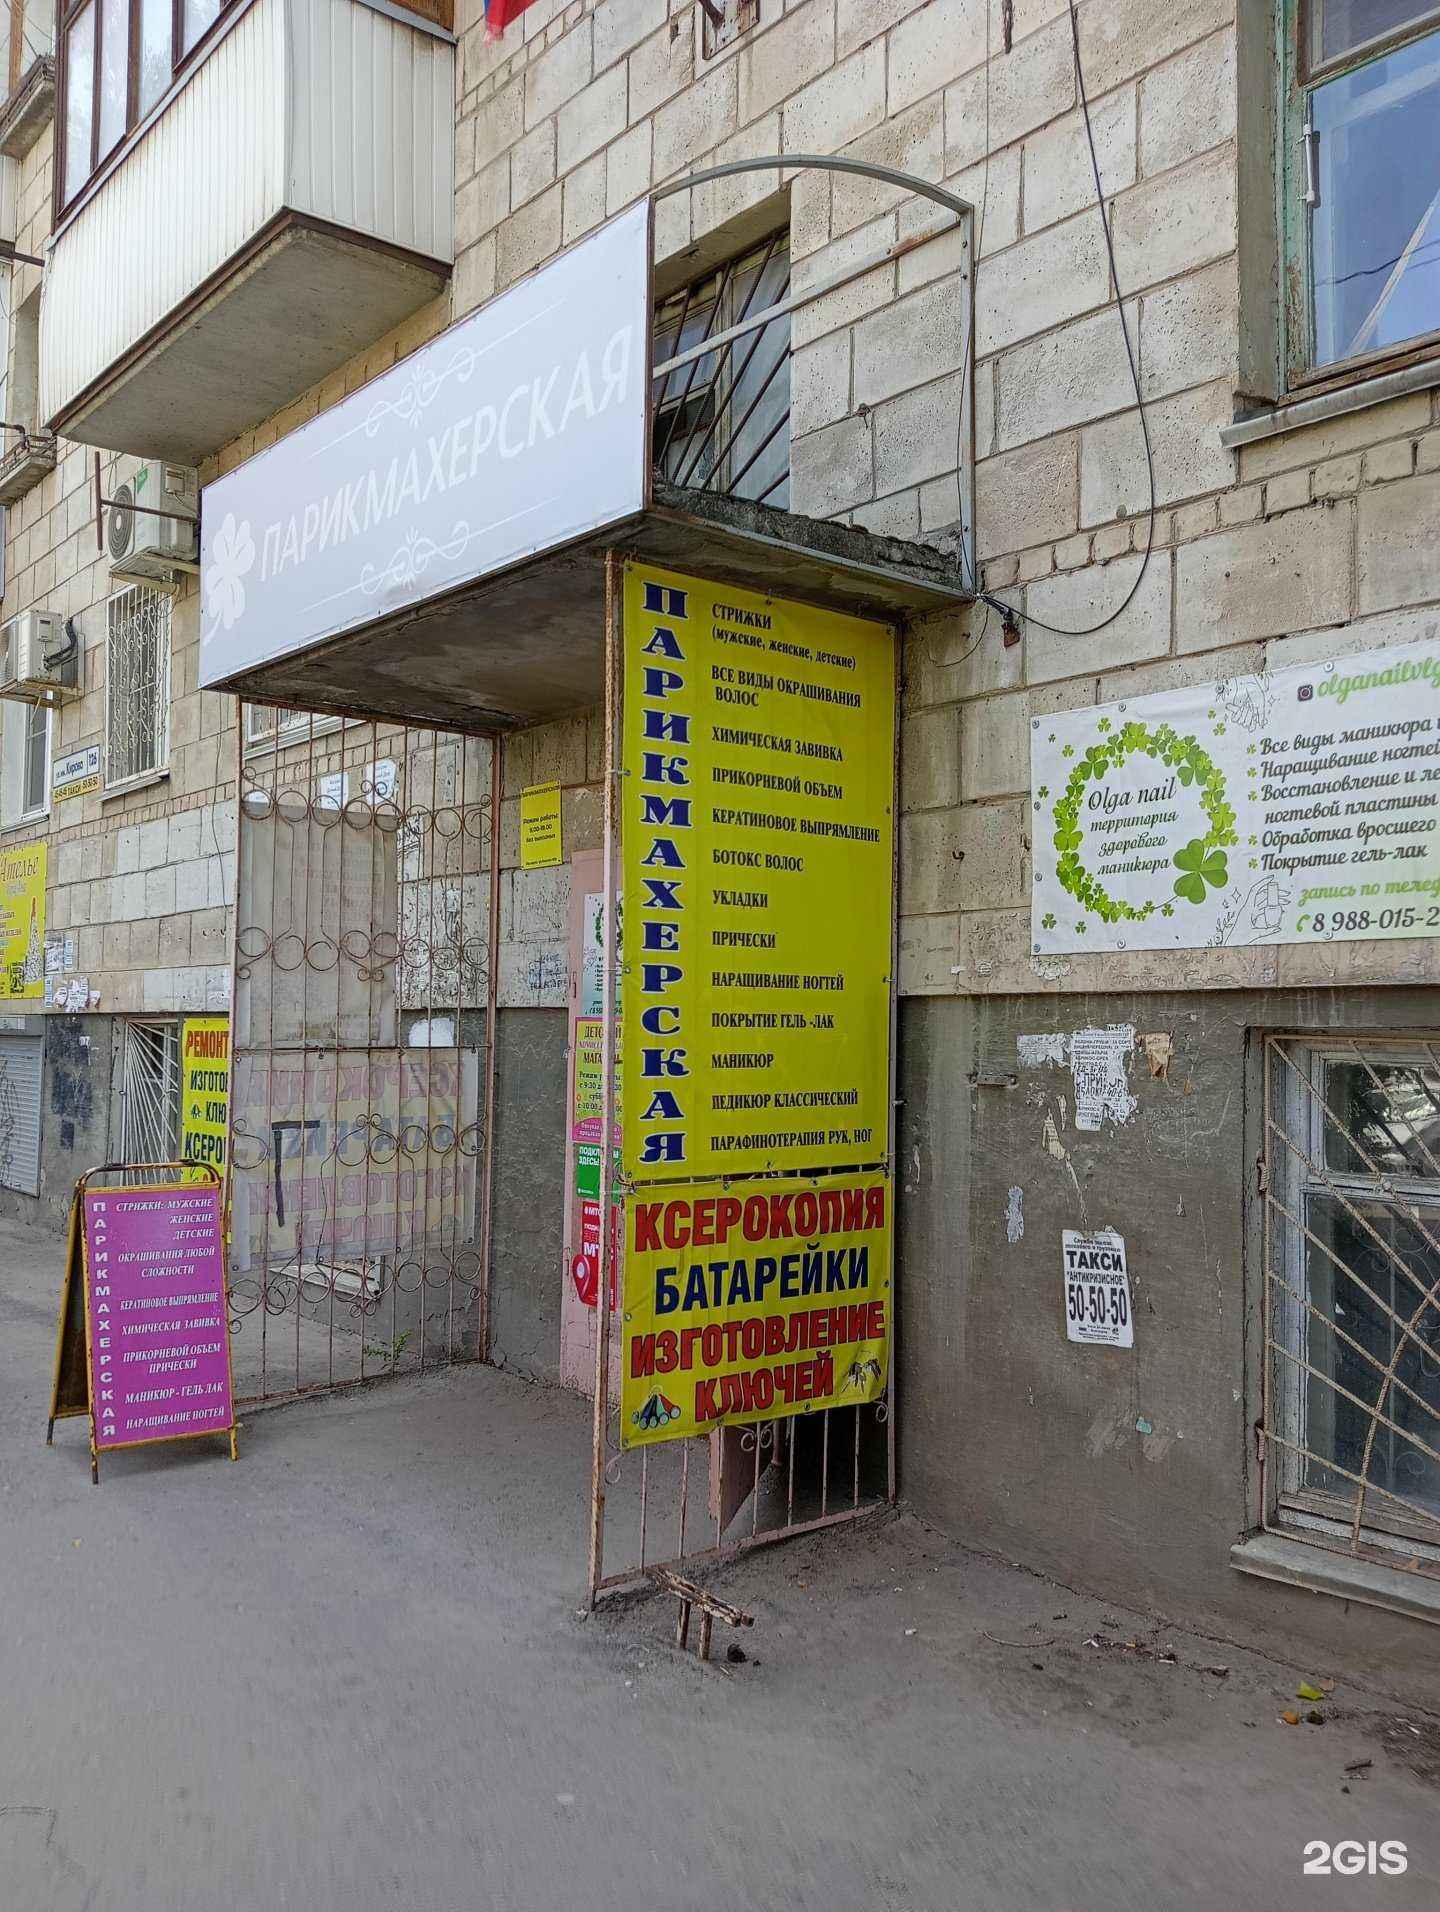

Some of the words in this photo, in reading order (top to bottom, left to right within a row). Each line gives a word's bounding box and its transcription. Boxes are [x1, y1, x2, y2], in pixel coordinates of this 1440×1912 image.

[261, 325, 633, 582] ПАРИКМАХЕРСКАЯ
[712, 603, 772, 630] СТРИЖКИ
[769, 639, 813, 661] женские,
[815, 653, 857, 672] детские)
[712, 665, 735, 683] ВСЕ
[738, 670, 774, 691] ВИДЫ
[777, 677, 861, 708] ОКРАШИВАНИЯ
[715, 686, 759, 707] ВОЛОС
[712, 726, 791, 753] ХИМИЧЕСКАЯ
[795, 740, 843, 762] ЗАВИВКА
[1260, 737, 1290, 755] Все
[1293, 734, 1335, 755] виды
[1339, 719, 1432, 744] маникюра
[1261, 751, 1380, 783] Наращивание
[712, 767, 801, 794] ПРИКОРНЕВОЙ
[804, 781, 843, 800] ОБЪЕМ
[1088, 787, 1133, 814] Olga
[1137, 776, 1176, 804] nail
[1261, 771, 1400, 801] Восстановление
[1404, 770, 1417, 783] и
[1265, 800, 1342, 824] ногтевой
[1345, 793, 1438, 815] пластины
[712, 808, 797, 832] КЕРАТИНОВОЕ
[800, 819, 880, 843] ВЫПРЯМЛЕНИЕ
[1090, 811, 1179, 833] территория
[1098, 832, 1168, 857] здорового
[1262, 828, 1353, 854] Обработка
[1357, 819, 1437, 845] вросшего
[713, 849, 762, 867] БОТОКС
[765, 854, 804, 872] ВОЛОС
[1097, 856, 1171, 875] маникюра
[1261, 851, 1349, 876] Покрытие
[1351, 845, 1428, 863] гель-лак
[640, 582, 692, 1163] ПАРИКМАХЕРСКАЯ
[713, 889, 768, 909] УКЛАДКИ
[1298, 884, 1357, 907] запись
[1360, 882, 1381, 897] по
[1312, 912, 1325, 932] 8
[1332, 906, 1440, 931] 988-015-2
[712, 930, 776, 948] ПРИЧЕСКИ
[712, 971, 800, 990] НАРАЩИВАНИЕ
[803, 973, 844, 991] НОГТЕЙ
[712, 1013, 777, 1028] ПОКРЫТИЕ
[781, 1014, 807, 1029] ГЕЛЬ
[712, 1053, 774, 1069] МАНИКЮР
[191, 1069, 228, 1091] ИЗГОТО
[712, 1094, 771, 1111] ПЕДИКЮР
[774, 1088, 858, 1108] КЛАССИЧЕСКИЙ
[711, 1130, 825, 1151] ПАРАФИНОТЕРАПИЯ
[828, 1130, 852, 1146] РУК,
[854, 1129, 872, 1143] НОГ
[116, 1201, 164, 1213] СТРИЖКИ:
[166, 1198, 213, 1210] МУЖСКИЕ
[168, 1213, 214, 1225] ЖЕНСКИЕ
[635, 1187, 884, 1252] КСЕРОКОПИЯ
[172, 1228, 215, 1240] ДЕТСКИЕ
[184, 1245, 215, 1259] ЛЮБОЙ
[1066, 1250, 1123, 1272] ТАКСИ
[141, 1265, 195, 1278] СЛОЖНОСТИ
[655, 1242, 869, 1315] БАТАРЕЙКИ
[120, 1297, 167, 1311] КЕРАТИНОВОЕ
[92, 1202, 116, 1436] ПАРИКМАХЕРСКАЯ
[121, 1321, 180, 1336] ХИМИЧЕСКАЯ
[184, 1317, 220, 1330] ЗАВИВКА
[631, 1301, 885, 1378] ИЗГОТОВЛЕНИЕ
[123, 1344, 189, 1363] ПРИКОРНЕВОЙ
[190, 1342, 221, 1355] ОБЪЕМ
[149, 1359, 197, 1374] ПРИЧЕСКИ
[125, 1390, 175, 1405] МАНИКЮР
[695, 1350, 834, 1423] КЛЮЧЕЙ
[126, 1412, 191, 1430] НАРАЩИВАНИЕ
